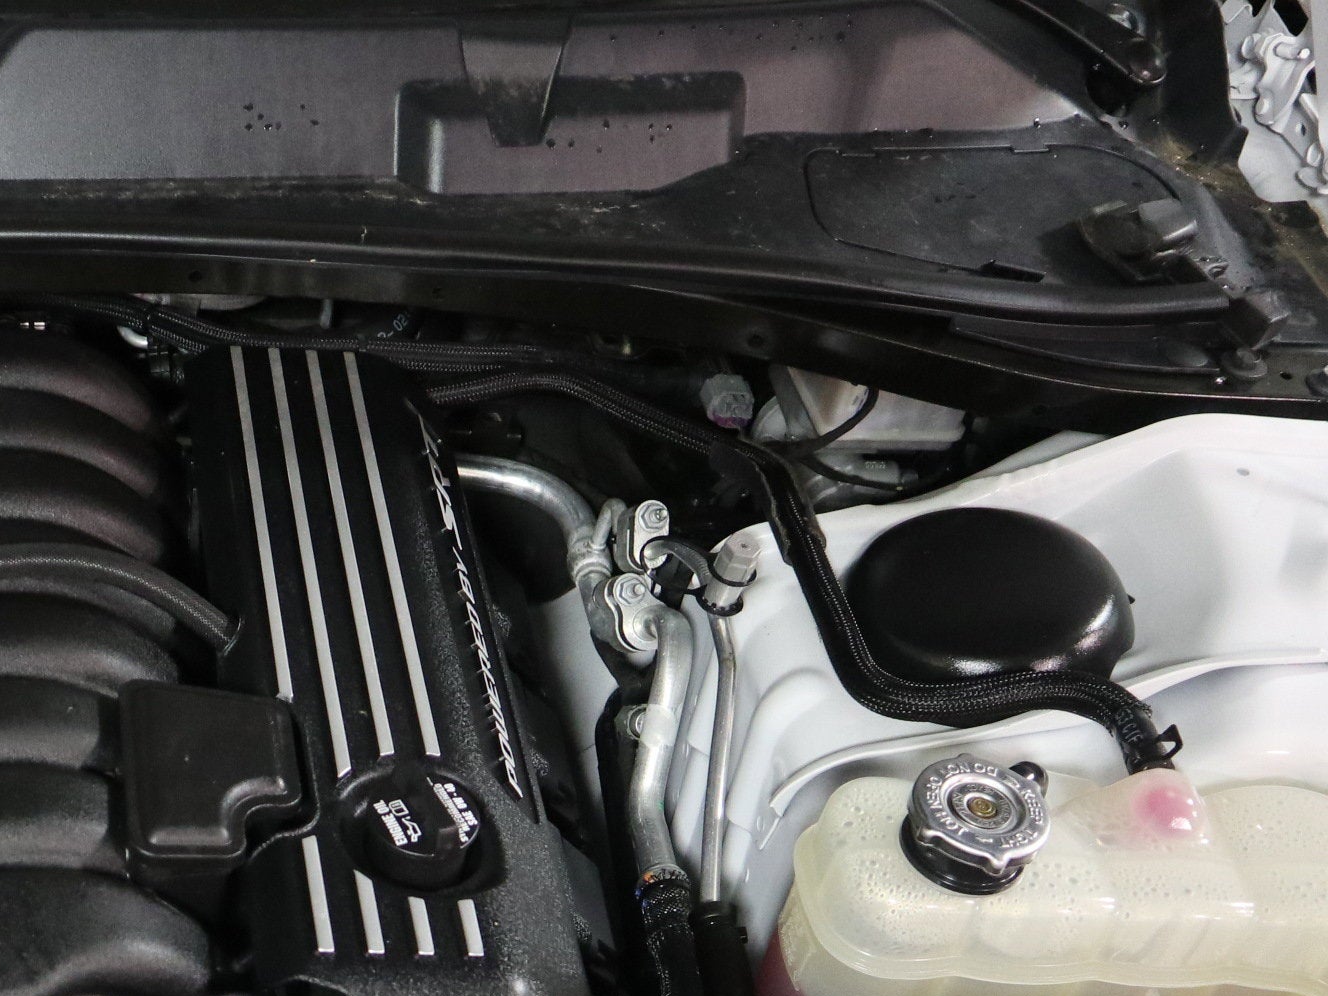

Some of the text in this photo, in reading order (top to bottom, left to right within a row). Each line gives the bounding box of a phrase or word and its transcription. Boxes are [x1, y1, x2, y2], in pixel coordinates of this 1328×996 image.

[466, 601, 523, 798] POWERED
[373, 799, 409, 847] ENGINE OIL
[462, 809, 479, 826] SAE
